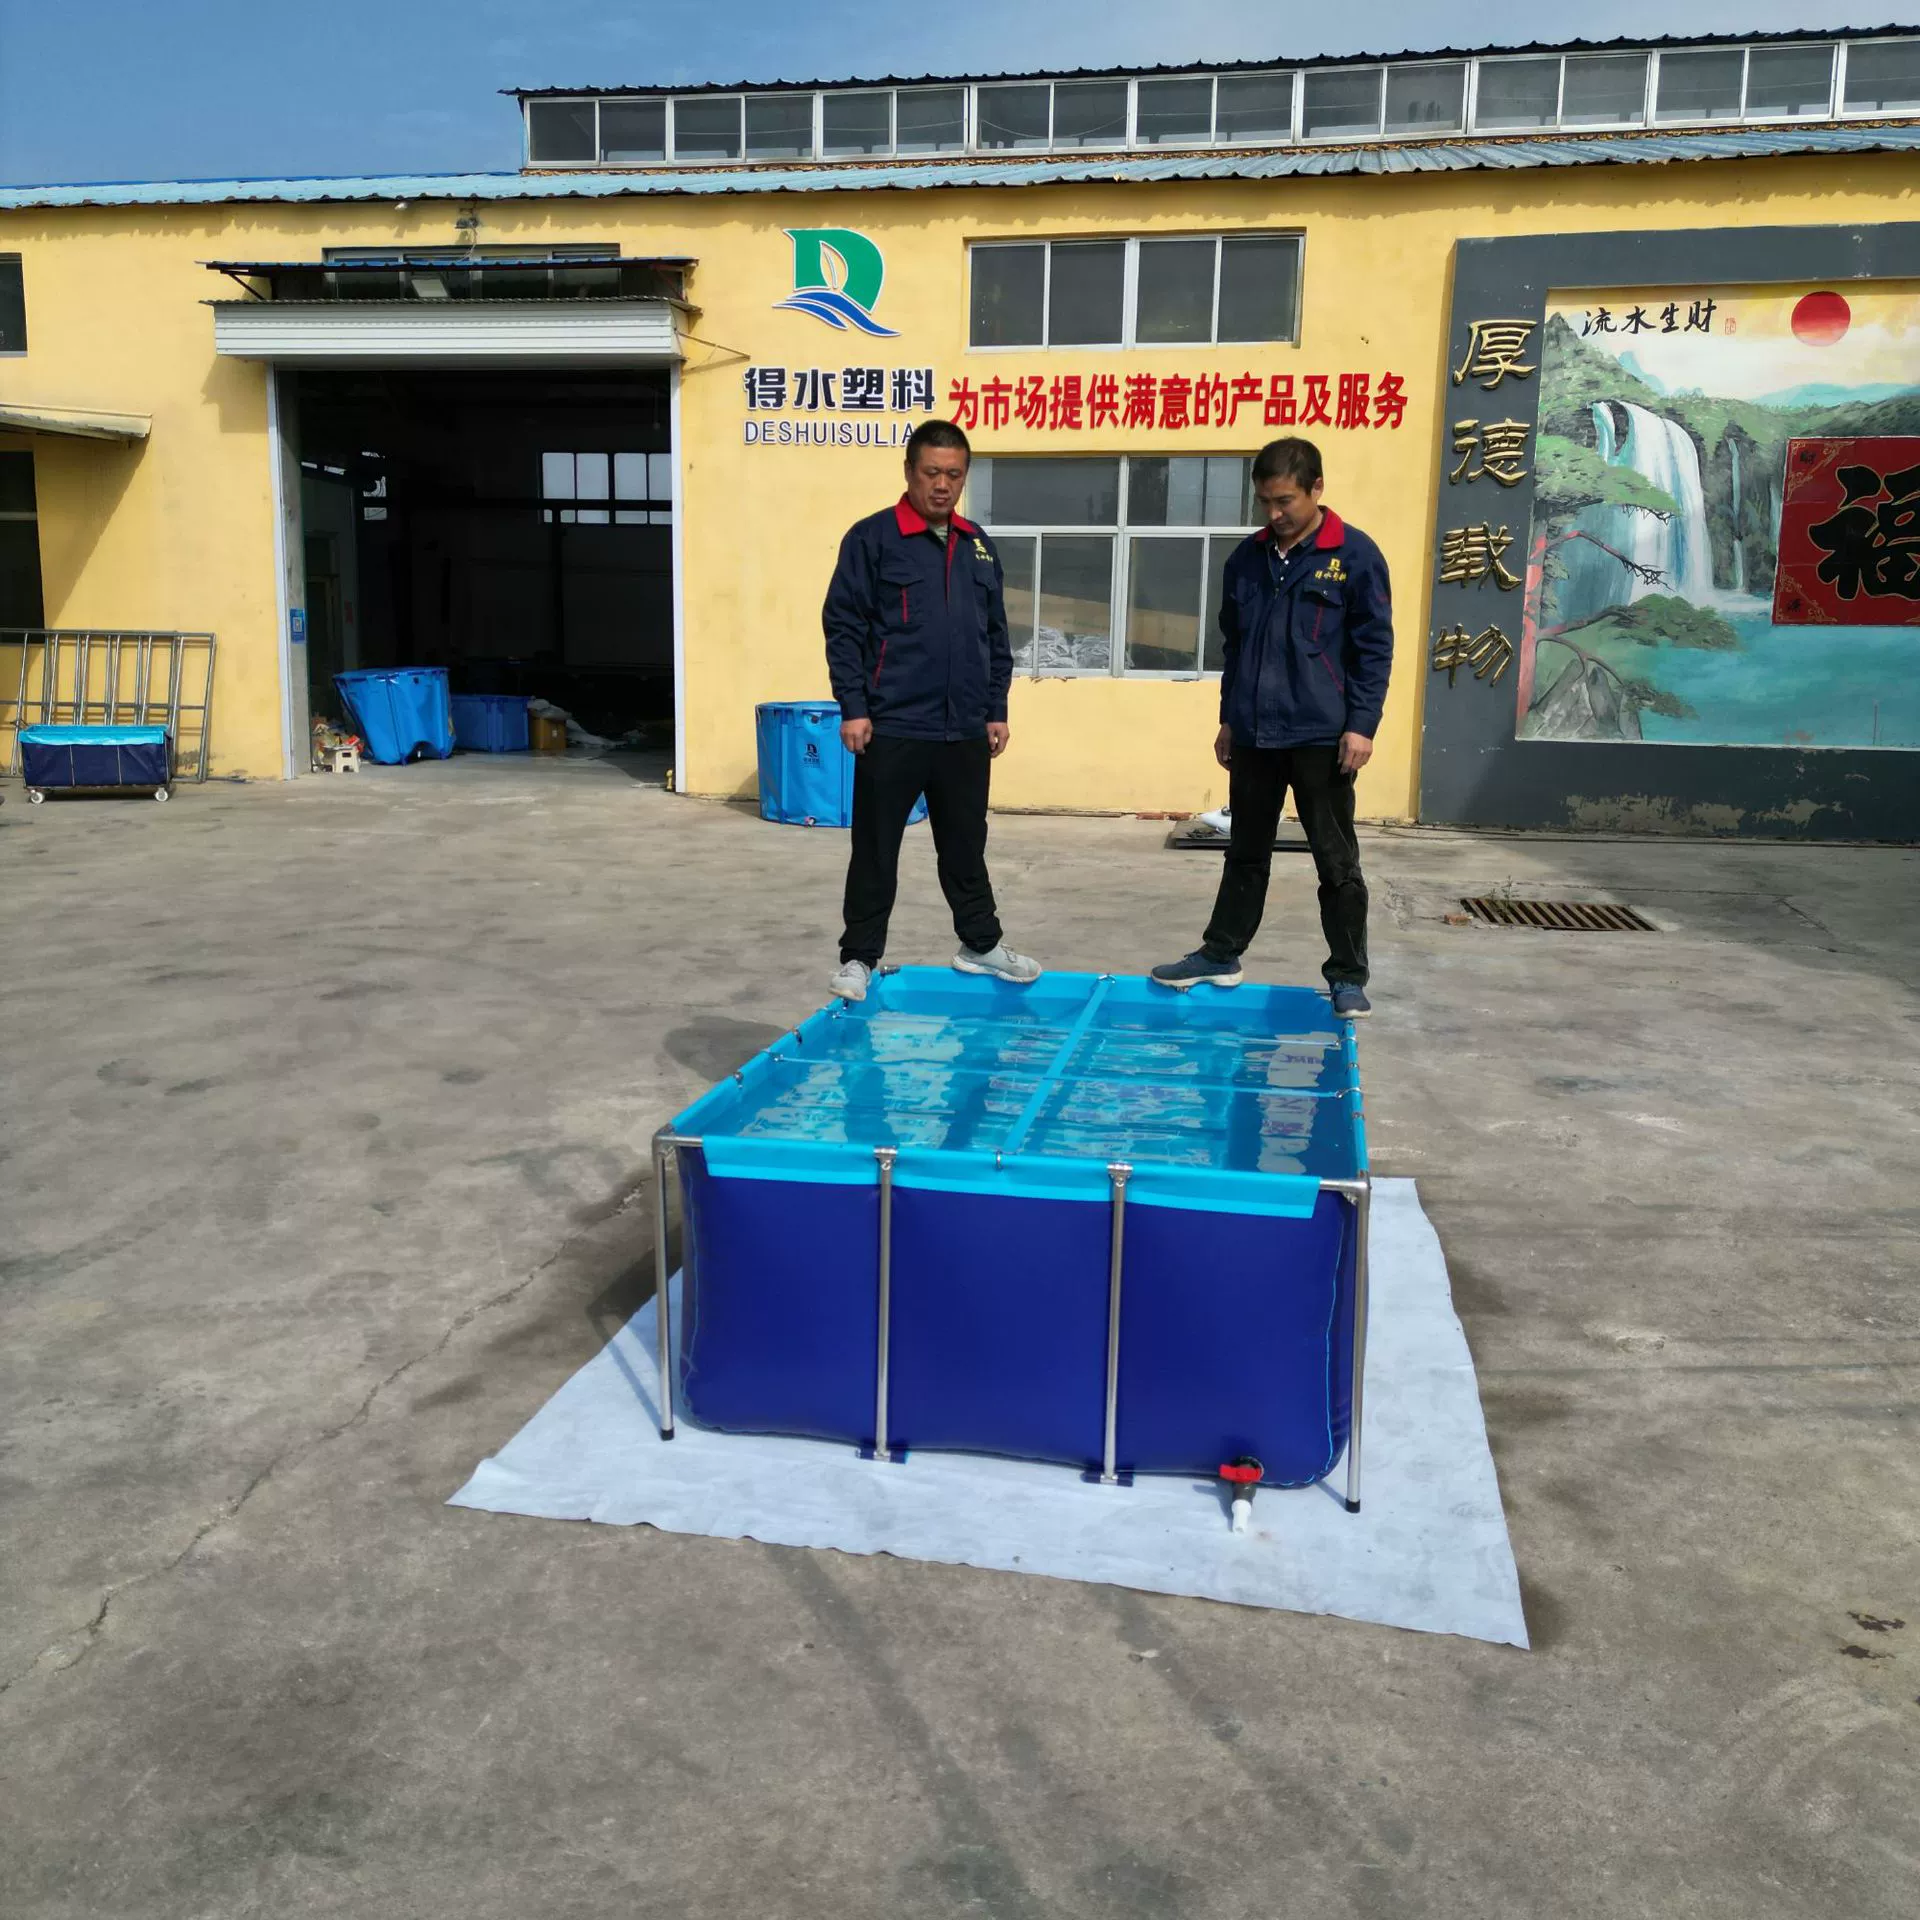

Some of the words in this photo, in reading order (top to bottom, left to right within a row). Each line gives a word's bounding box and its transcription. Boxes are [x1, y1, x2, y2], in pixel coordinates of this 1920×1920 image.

[744, 367, 935, 411] 得水塑料
[948, 371, 1408, 431] 为市场提供满意的产品及服务
